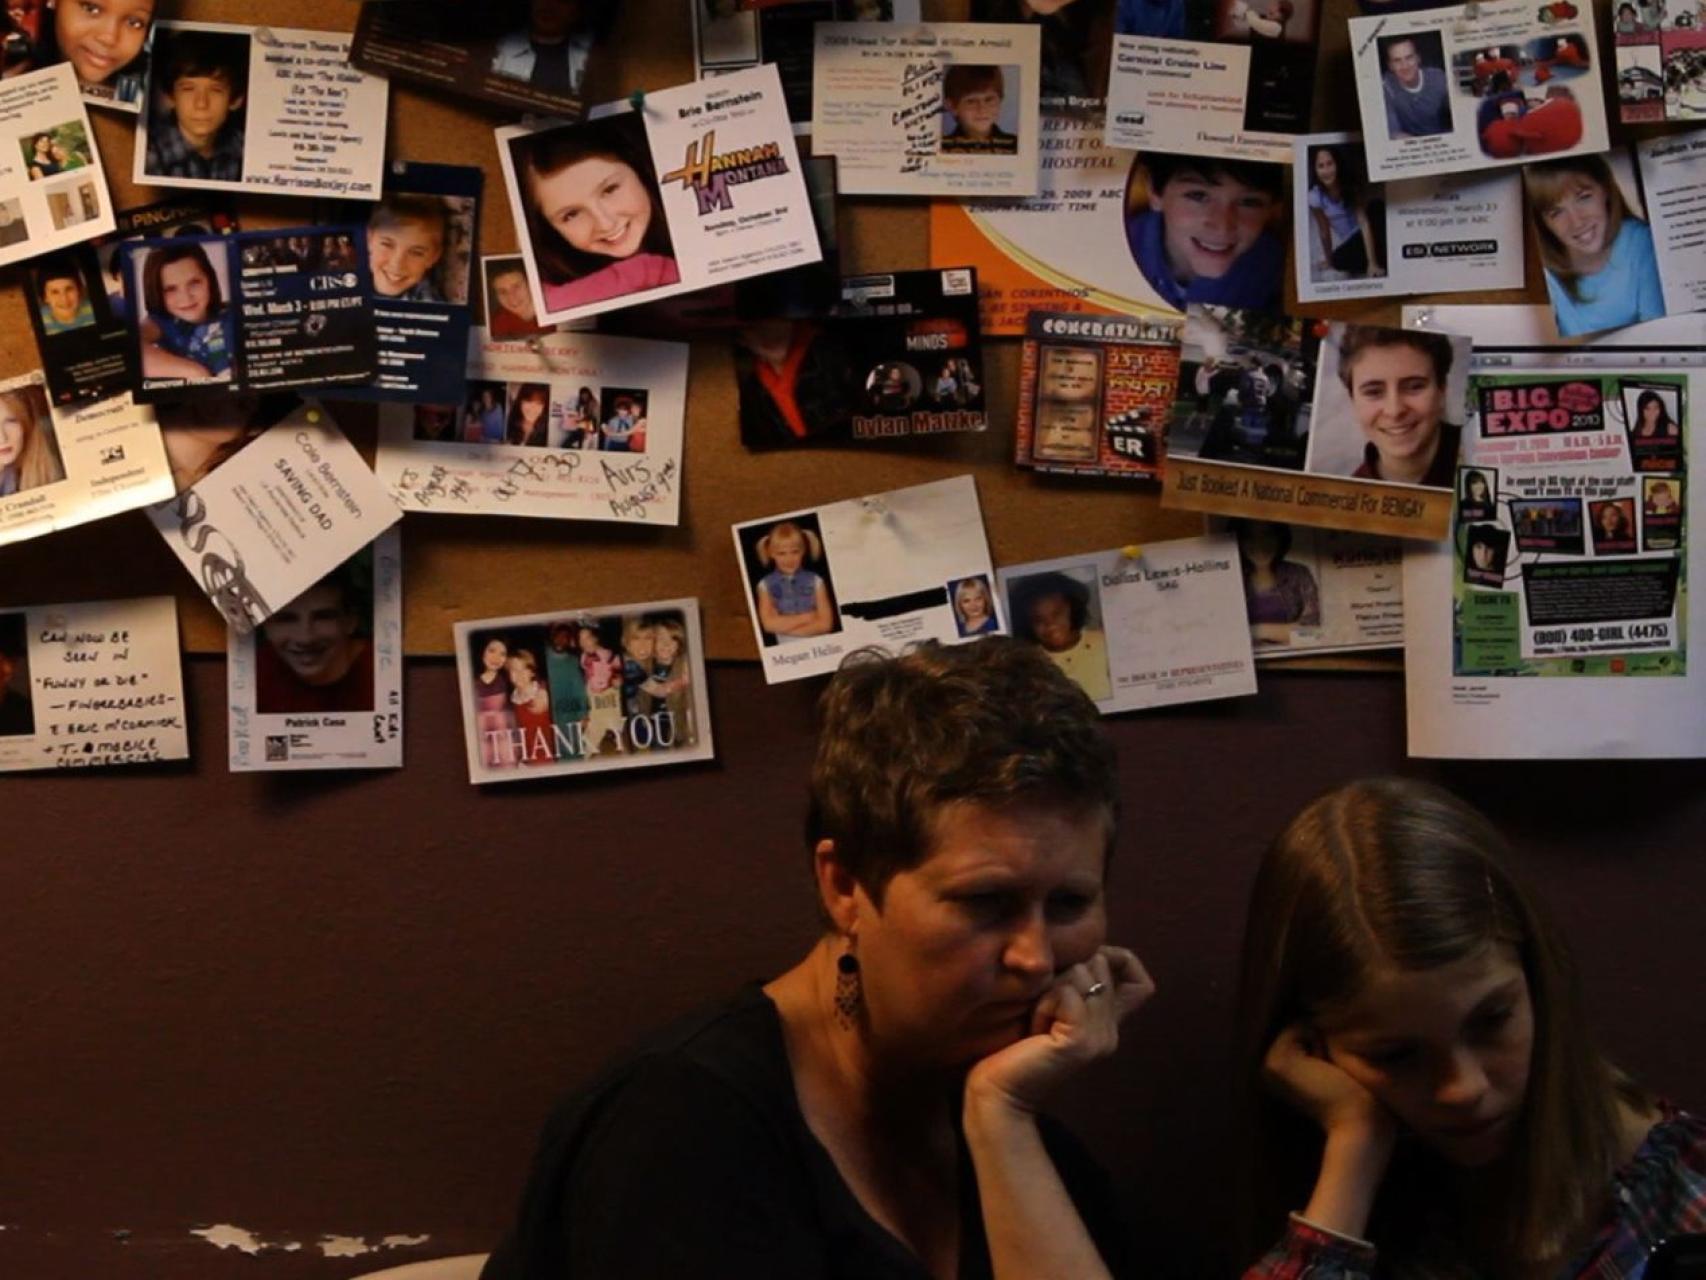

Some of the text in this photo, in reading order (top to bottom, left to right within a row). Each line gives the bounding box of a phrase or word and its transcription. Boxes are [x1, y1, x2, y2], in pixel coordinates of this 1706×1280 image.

[1117, 53, 1227, 71] Carnival Cruise Line
[678, 104, 703, 120] Brie
[704, 90, 763, 112] Bernstein
[661, 129, 780, 191] HANNAH
[1041, 156, 1116, 170] HOSPITAL
[695, 157, 790, 217] MONTANA
[1063, 189, 1092, 199] 2009
[1099, 188, 1123, 199] ABC
[1433, 242, 1495, 254] NETWORK
[906, 333, 949, 351] MINDS
[1486, 409, 1570, 434] EXPO
[1113, 436, 1145, 458] ER
[295, 432, 363, 520] Cole Bernstein
[600, 456, 651, 493] Airs
[273, 458, 333, 531] SAVING DAD
[1176, 469, 1197, 491] Just
[1201, 473, 1239, 496] Booked
[1252, 480, 1294, 503] National
[1297, 484, 1358, 511] Commercial
[1360, 492, 1378, 511] For
[1381, 495, 1427, 519] BENGAY
[1101, 559, 1232, 588] Dallas Lewis-Hollins
[40, 630, 129, 644] CAN NOW BE
[1628, 622, 1668, 641] (4475)
[62, 648, 129, 663] SEEN IN
[771, 649, 811, 668] Megan
[93, 678, 110, 687] OR
[68, 725, 99, 735] ERIC
[285, 717, 319, 729] Patrick
[485, 710, 676, 764] THANK YOU
